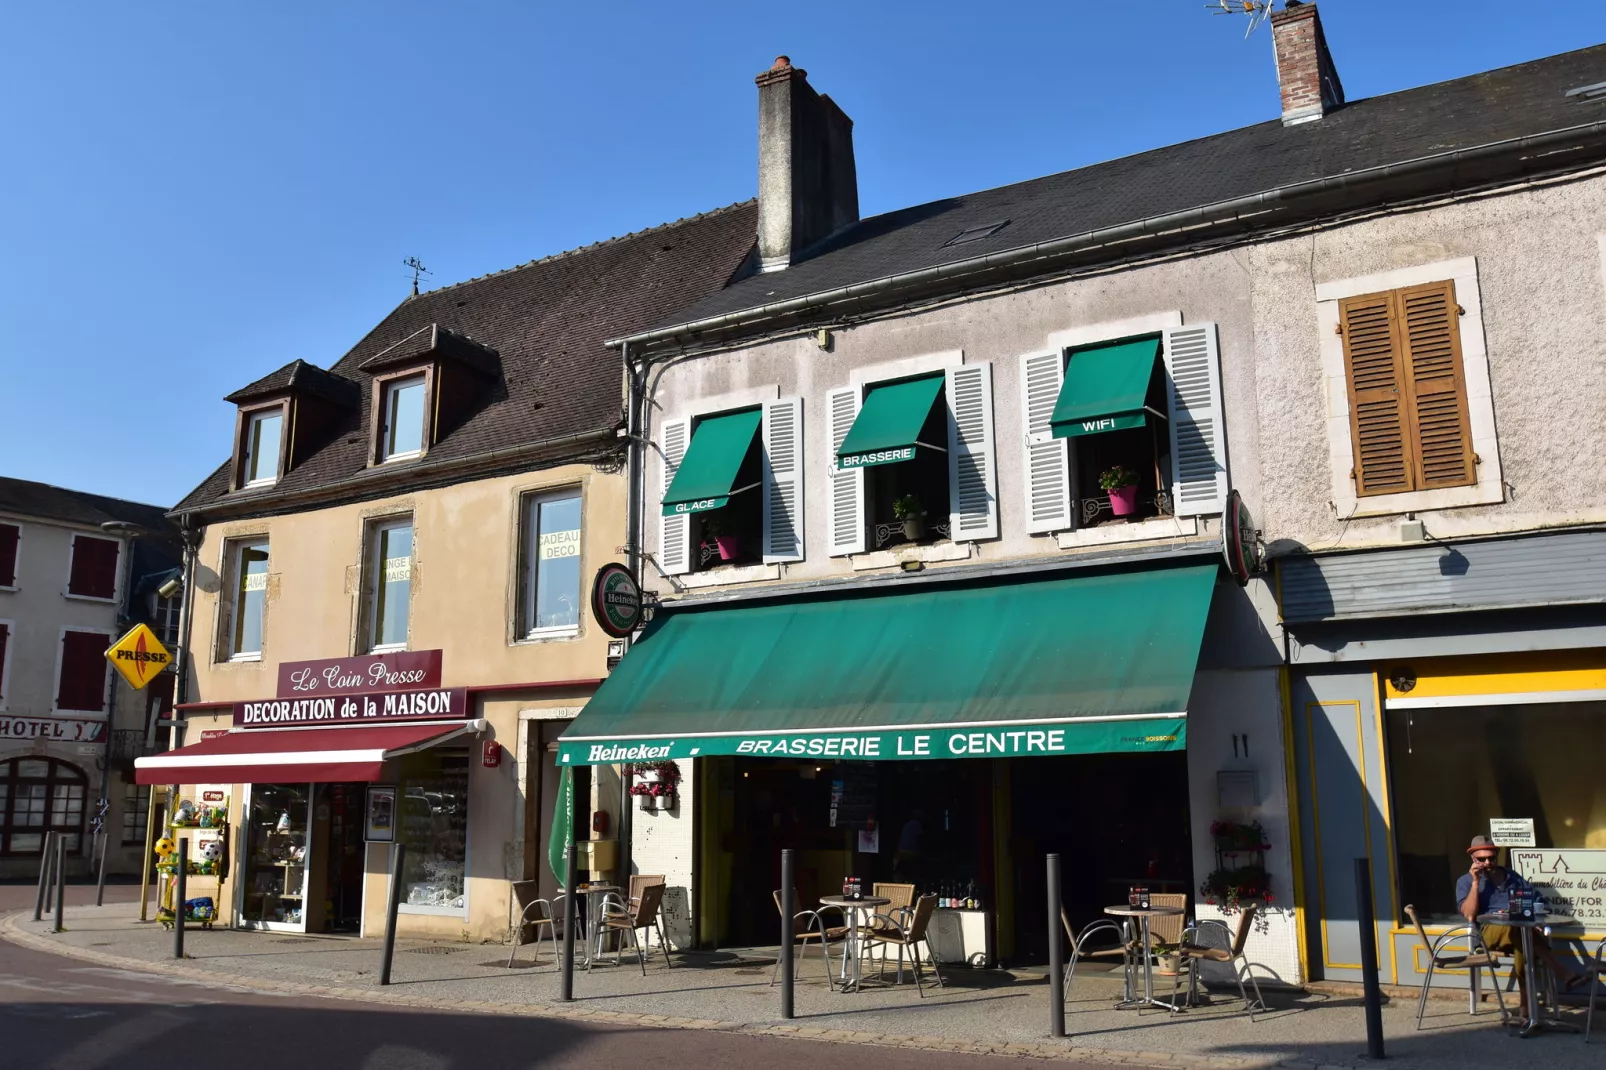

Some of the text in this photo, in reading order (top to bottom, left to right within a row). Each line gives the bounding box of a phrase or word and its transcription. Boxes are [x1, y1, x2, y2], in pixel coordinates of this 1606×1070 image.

[1082, 418, 1115, 431] WIFI
[843, 448, 912, 467] BRASSERIE
[675, 499, 715, 513] GLACE
[547, 545, 575, 557] DECO
[116, 649, 168, 663] PRESSE
[291, 662, 426, 691] Le Coin Presse
[243, 691, 452, 723] DECORATION de la MAISON
[0, 720, 64, 738] HOTEL
[736, 729, 1065, 756] BRASSERIE LE CENTRE
[588, 742, 671, 762] Heineken
[1577, 879, 1588, 889] du
